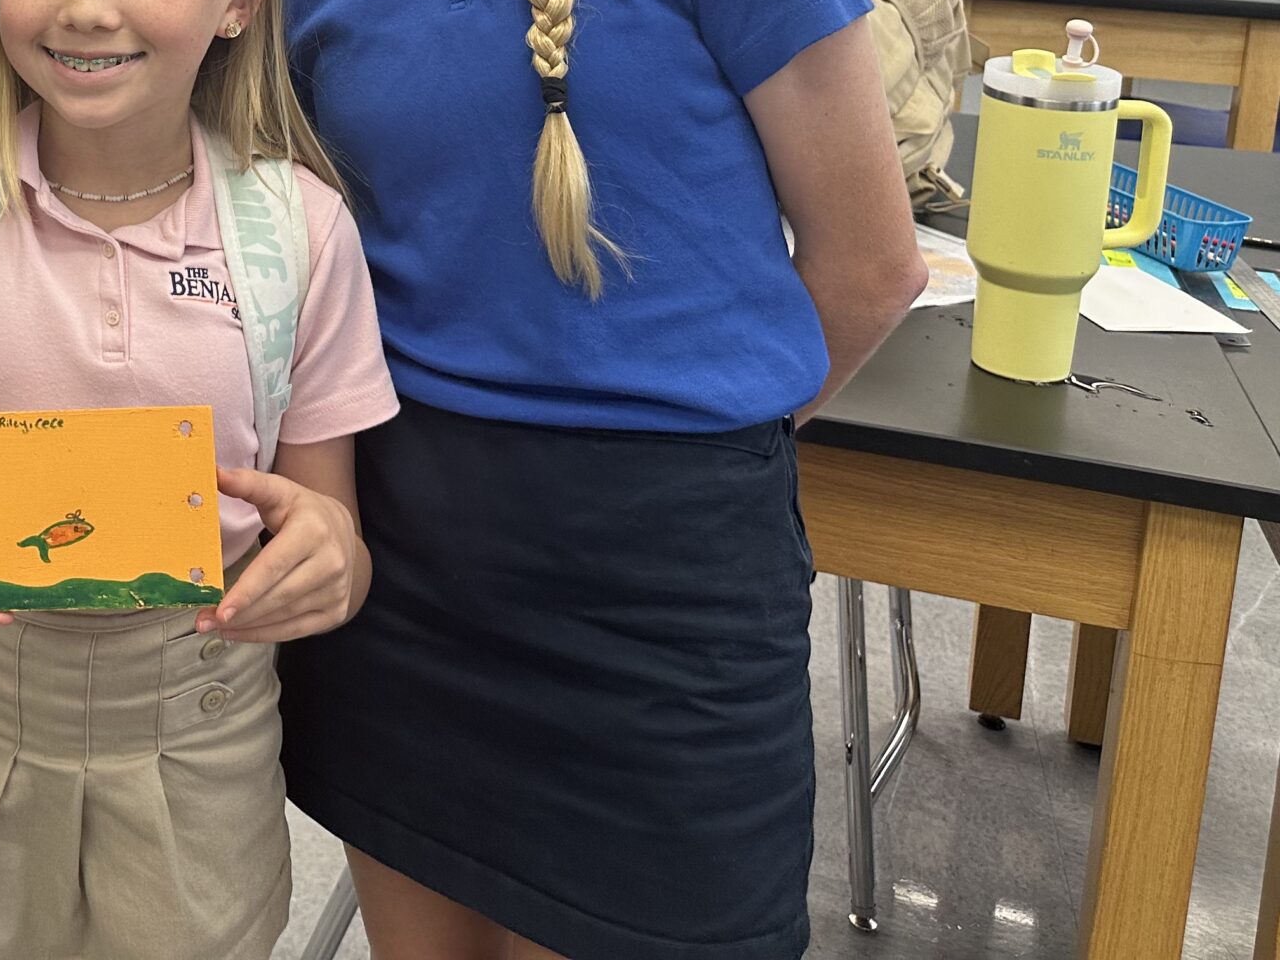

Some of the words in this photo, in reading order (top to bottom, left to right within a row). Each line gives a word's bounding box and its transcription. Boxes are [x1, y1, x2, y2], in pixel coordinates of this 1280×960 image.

[1037, 149, 1095, 161] STANLEY
[185, 267, 209, 280] THE
[169, 271, 237, 304] BENJA
